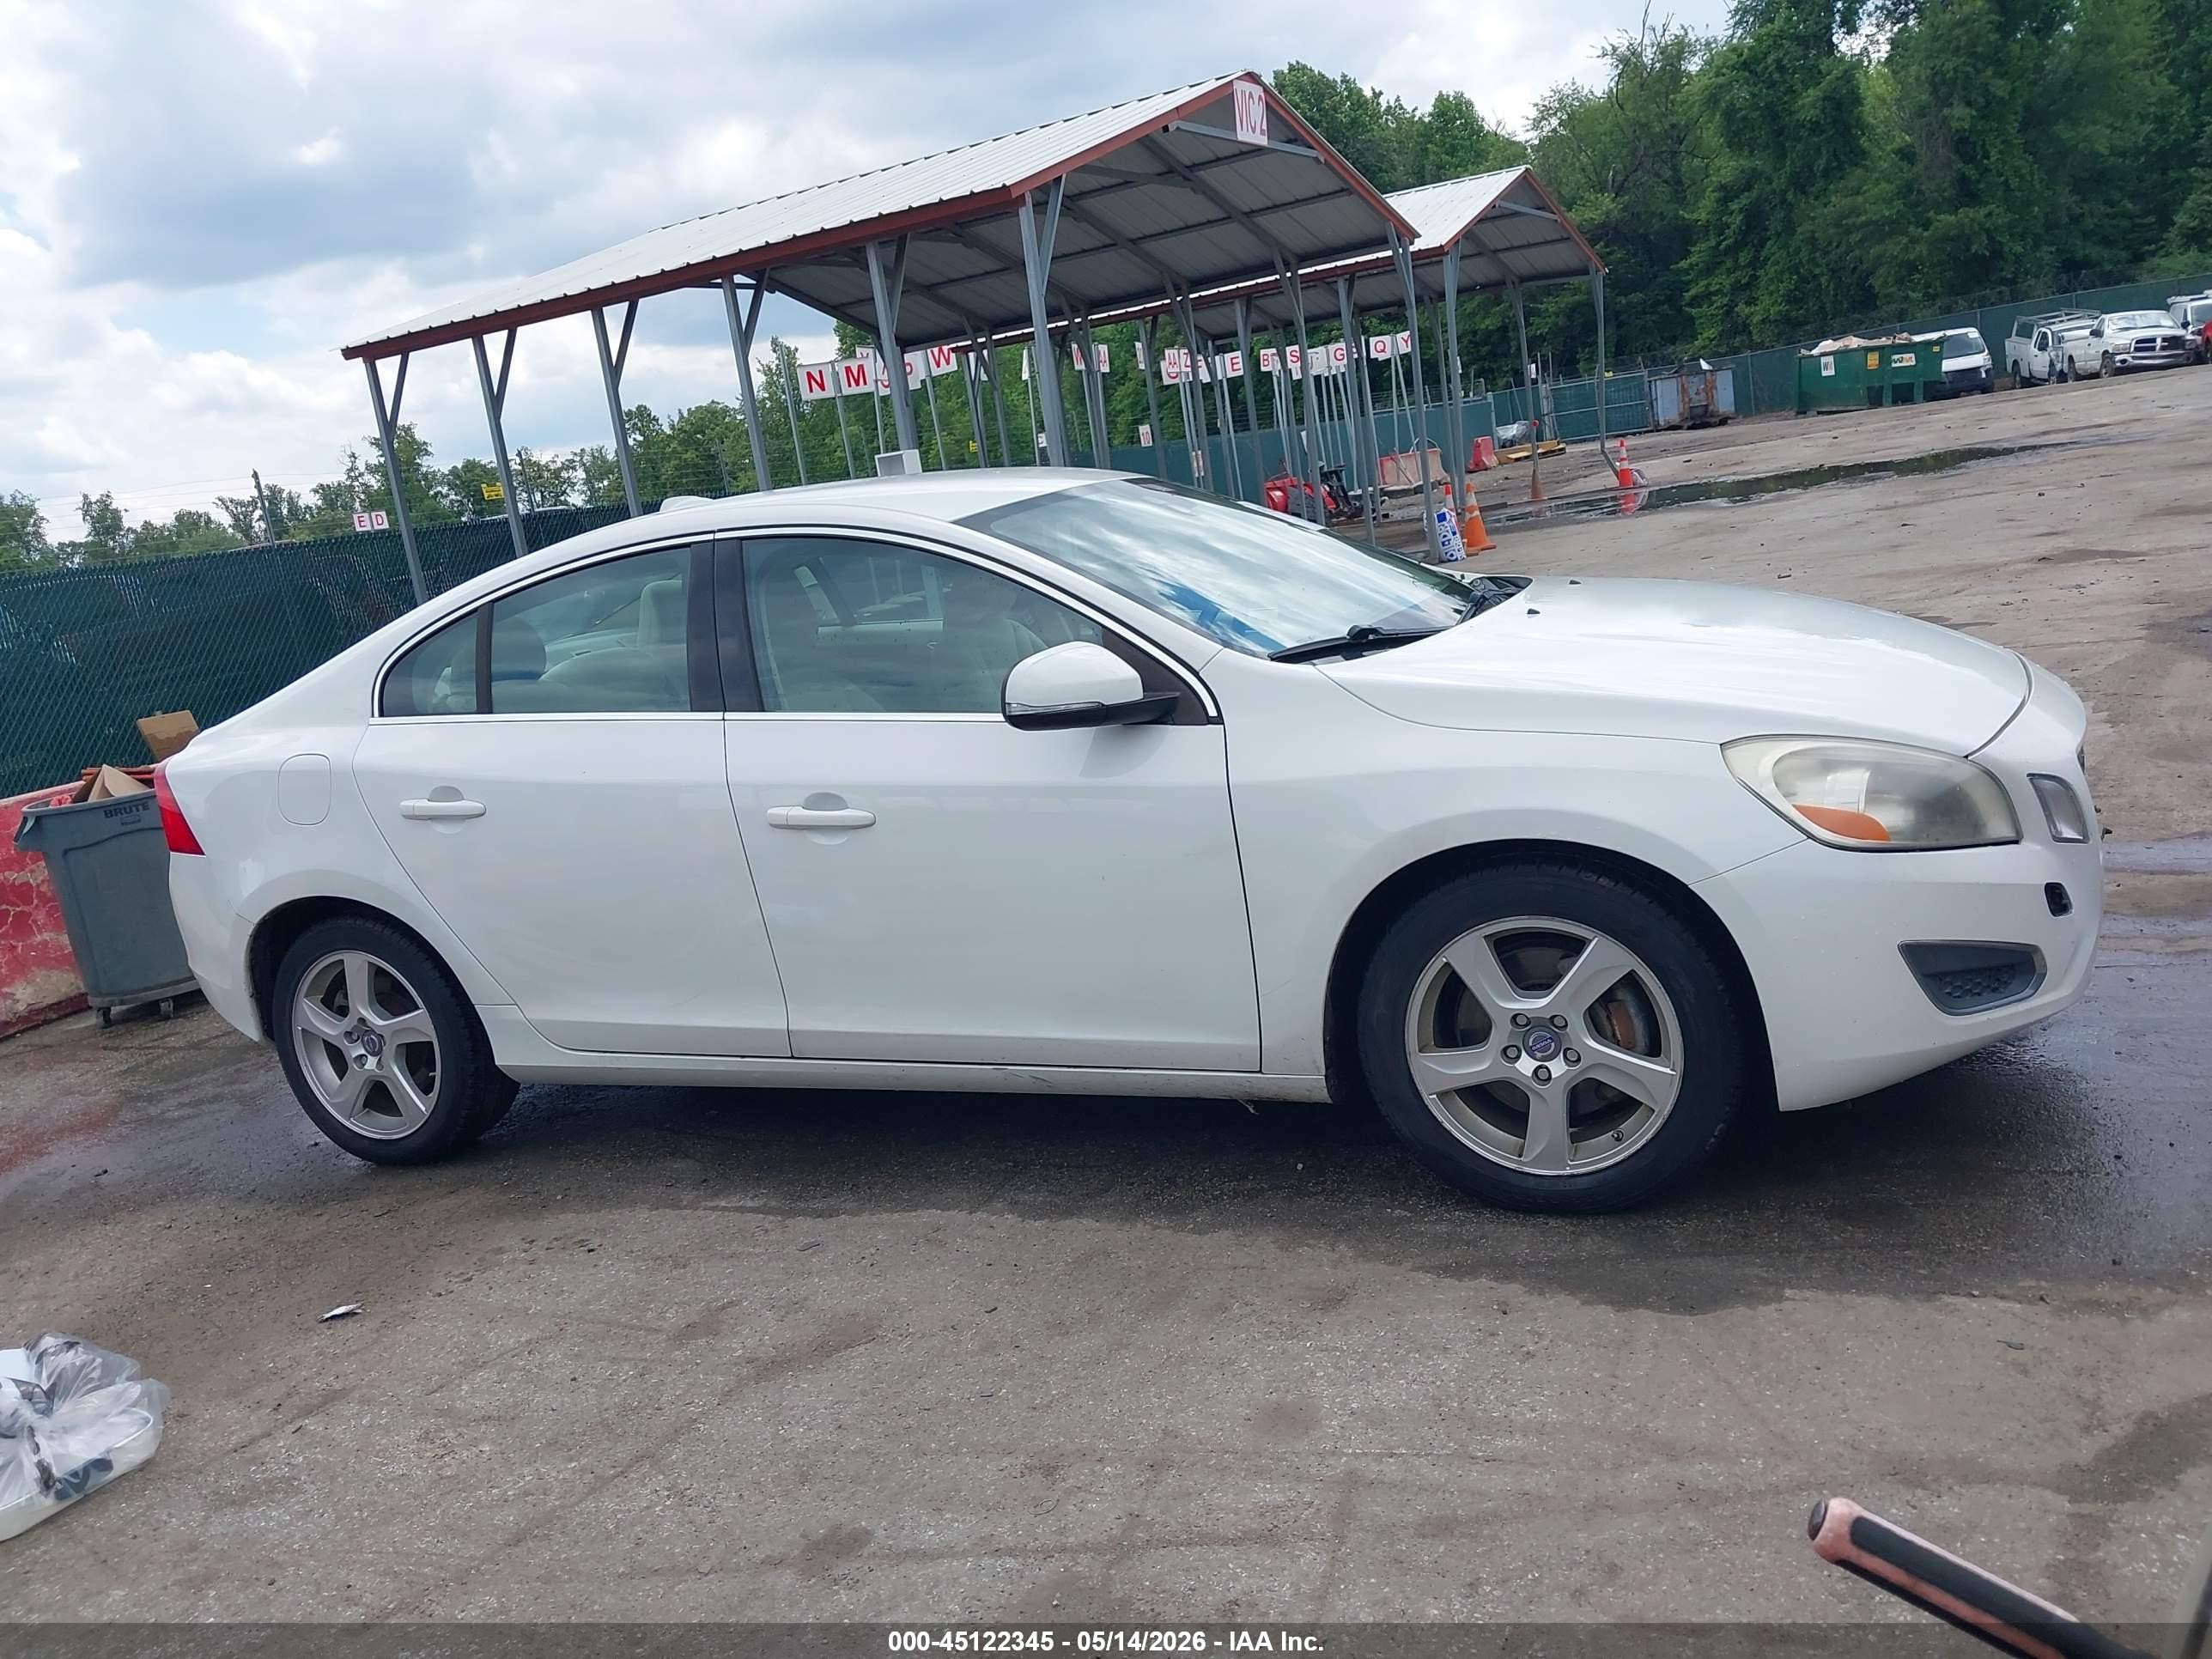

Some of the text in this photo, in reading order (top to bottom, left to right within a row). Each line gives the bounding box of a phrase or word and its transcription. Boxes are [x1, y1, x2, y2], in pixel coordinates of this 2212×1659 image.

[1374, 340, 1388, 355] Q
[1401, 335, 1411, 349] Y
[930, 345, 952, 368] W
[1261, 353, 1271, 368] B
[1289, 349, 1300, 363] S
[1333, 347, 1346, 362] G
[1230, 356, 1242, 372] E
[805, 369, 826, 393] N
[844, 363, 868, 388] M
[357, 515, 366, 528] E
[375, 514, 385, 526] D
[104, 801, 150, 817] BRUTE
